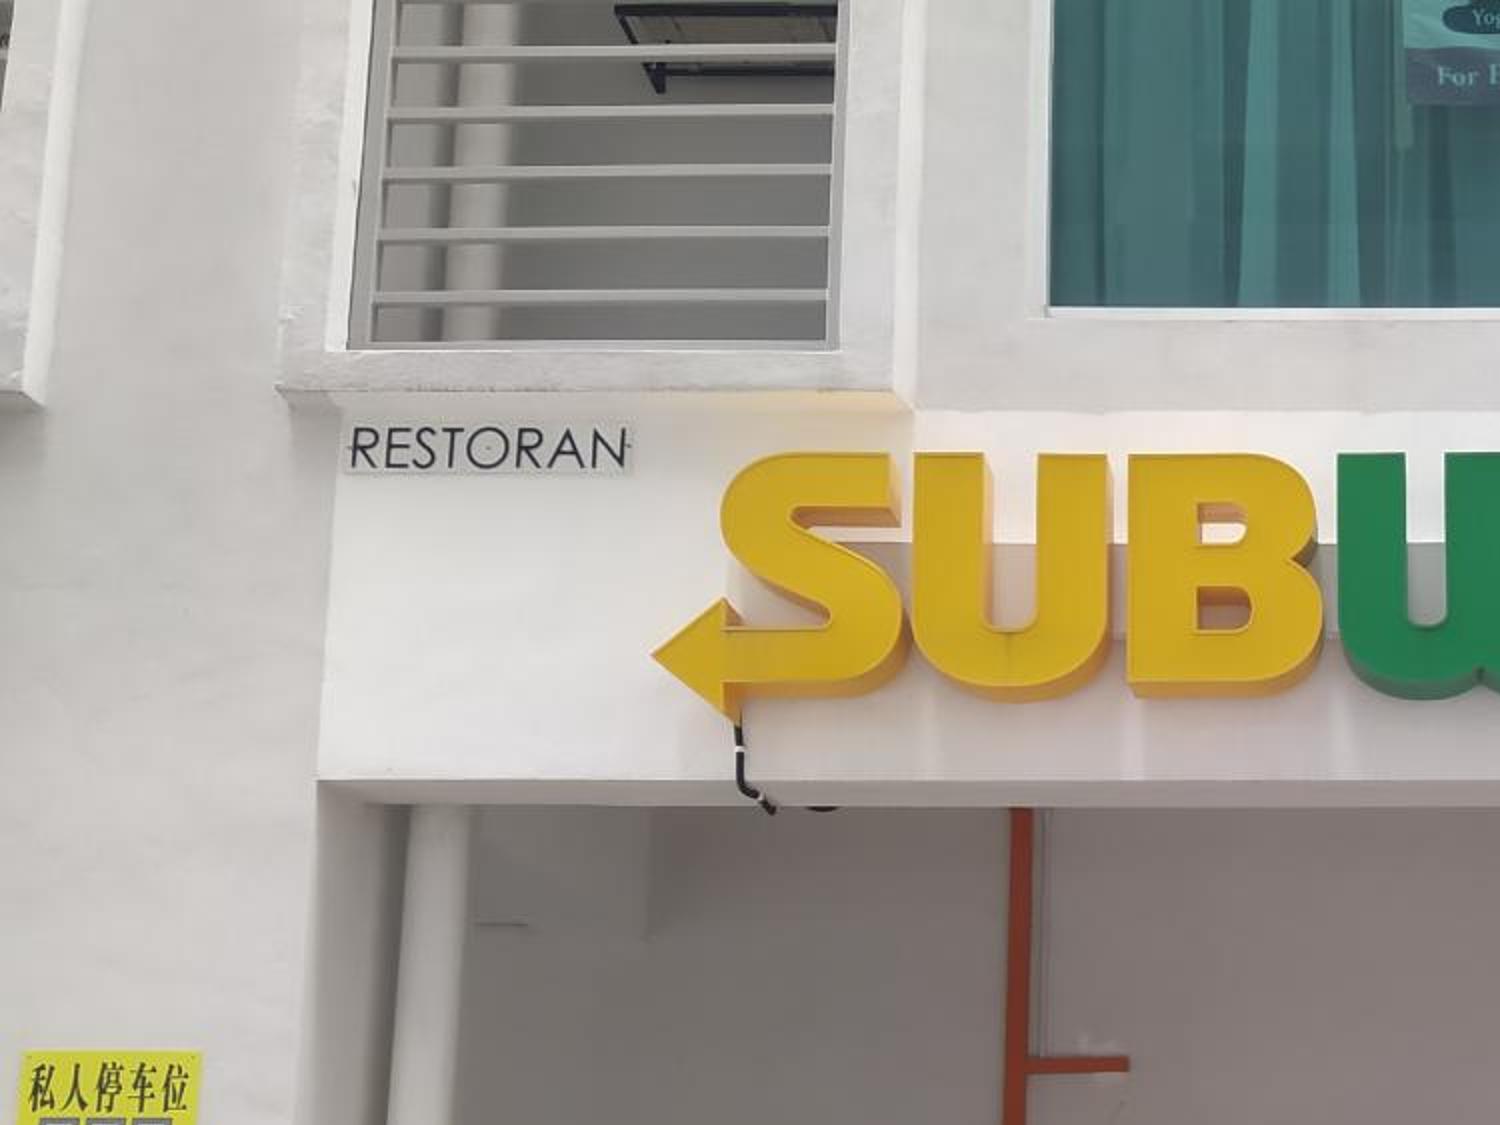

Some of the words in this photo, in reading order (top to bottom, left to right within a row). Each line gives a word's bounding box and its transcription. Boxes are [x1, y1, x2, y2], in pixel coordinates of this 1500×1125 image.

[1437, 66, 1479, 87] For
[350, 426, 627, 469] RESTORAN
[28, 1061, 190, 1113] 私人停车位
